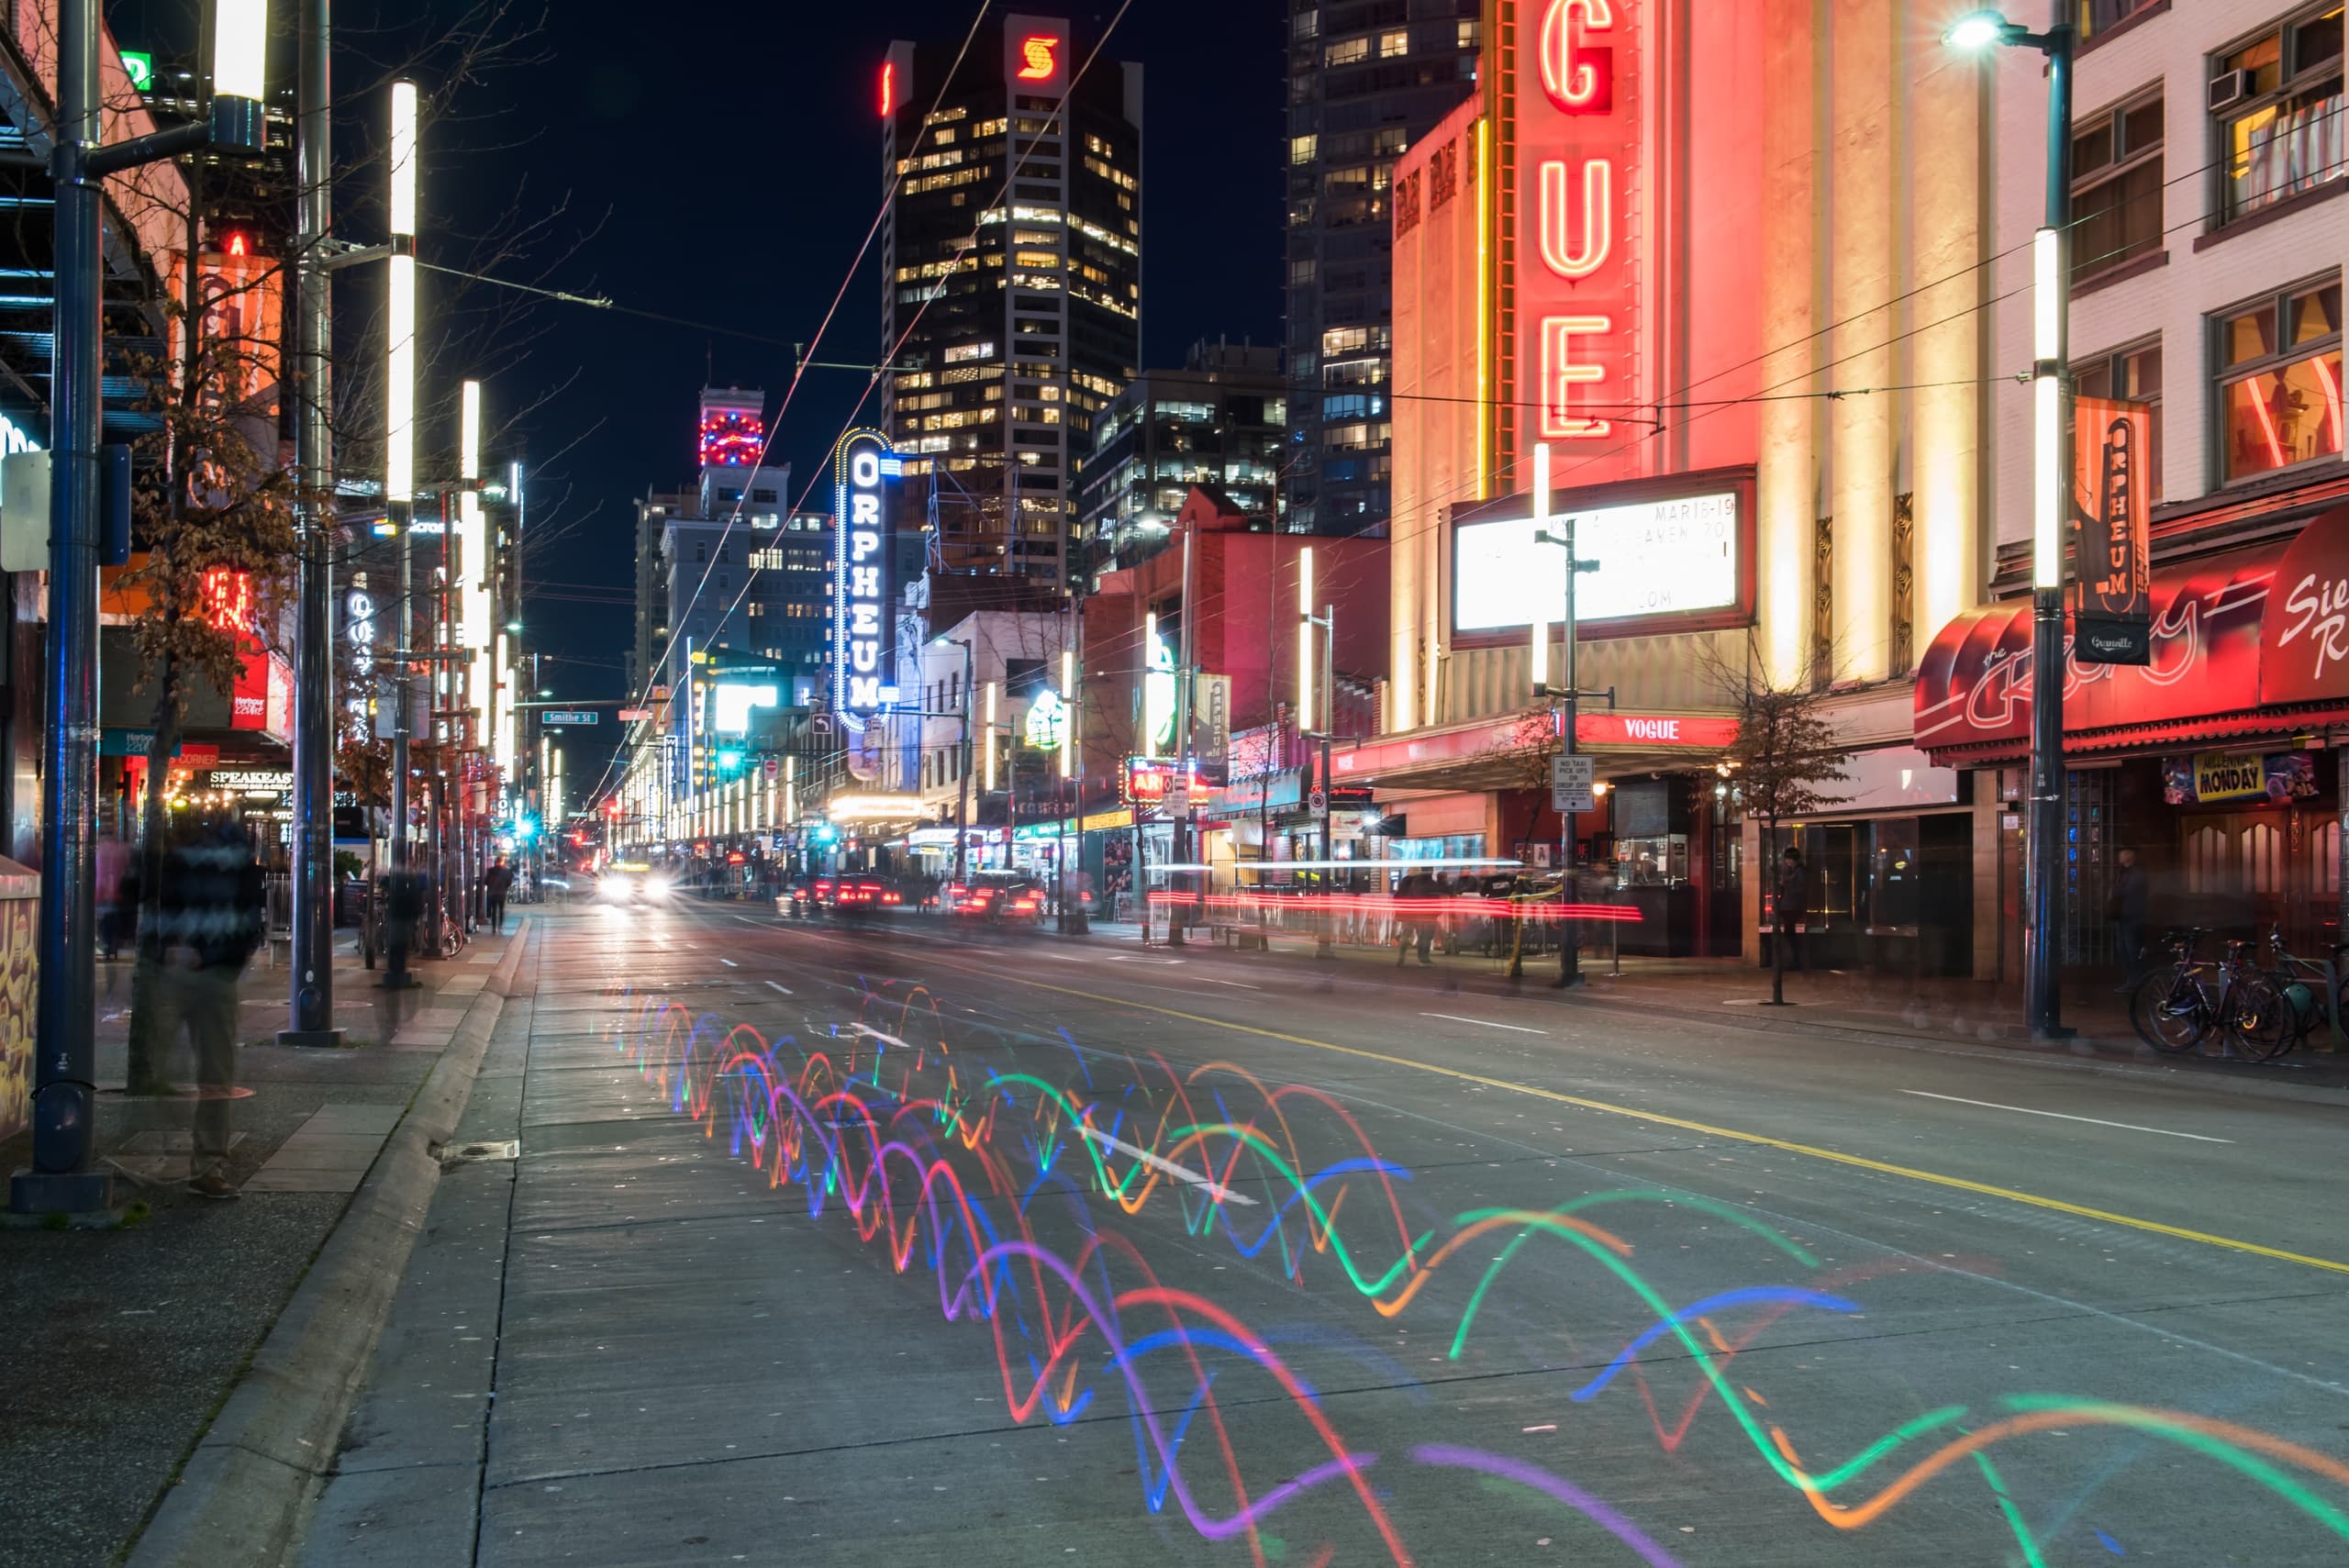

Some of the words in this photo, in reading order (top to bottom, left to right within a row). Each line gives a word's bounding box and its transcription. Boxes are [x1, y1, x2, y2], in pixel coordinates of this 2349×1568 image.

[2110, 428, 2127, 595] ORPHEUM
[851, 452, 879, 707] ORPHEUM
[1966, 601, 2198, 729] Roy
[1982, 647, 2007, 667] the
[550, 713, 579, 722] Smithe
[583, 713, 590, 722] St
[1624, 718, 1680, 740] VOGUE
[179, 754, 217, 765] CORNER
[2199, 767, 2260, 795] MONDAY
